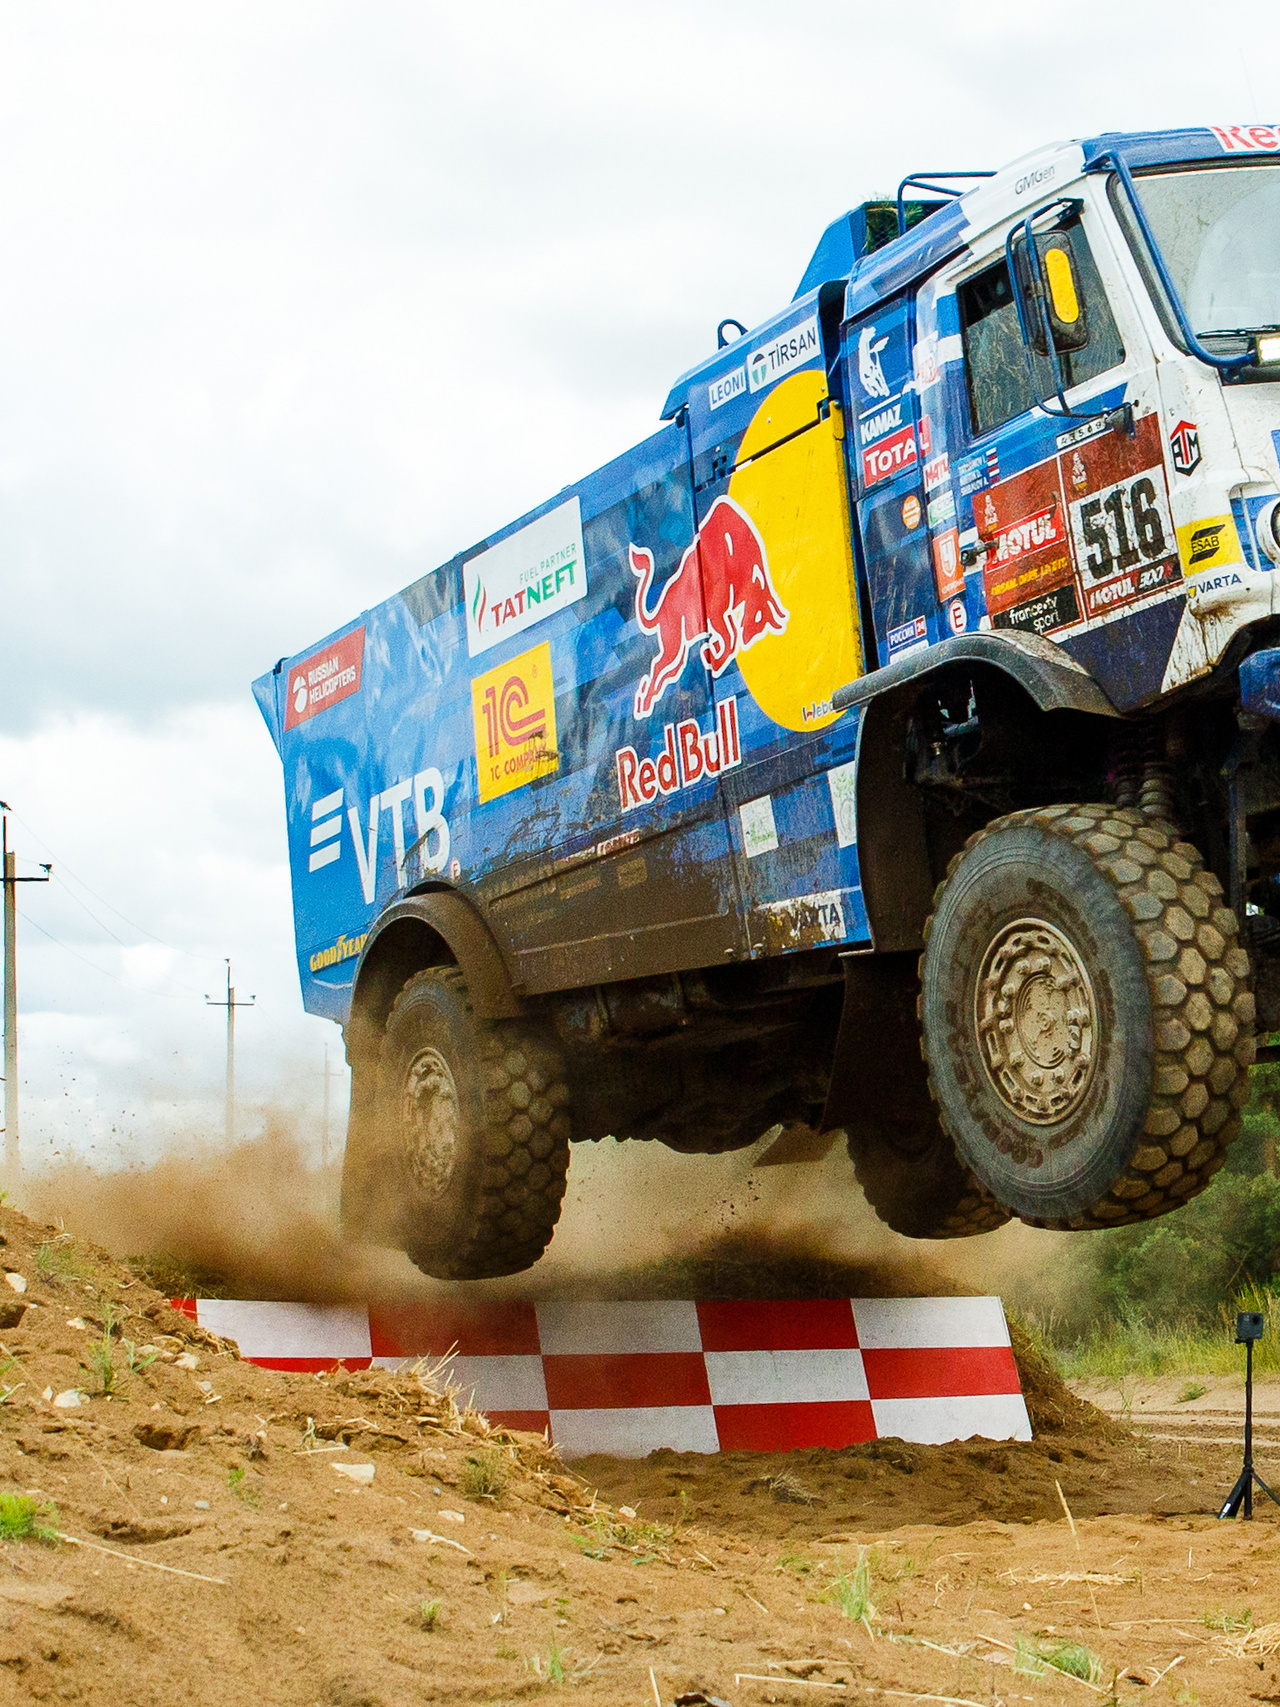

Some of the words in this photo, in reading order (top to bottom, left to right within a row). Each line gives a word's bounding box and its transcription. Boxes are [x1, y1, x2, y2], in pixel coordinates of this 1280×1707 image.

[710, 375, 745, 405] LEONI
[861, 403, 904, 445] KAMAZ
[866, 423, 930, 477] TOTAL
[992, 513, 1057, 564] MOTUL
[1080, 477, 1167, 581] 516
[1190, 535, 1220, 554] ESAB
[519, 565, 539, 585] FUEL
[540, 543, 577, 573] PARTNER
[1197, 573, 1242, 594] VARTA
[490, 560, 578, 628] TATNEFT
[1090, 577, 1135, 610] MOTUL
[1033, 609, 1061, 635] sport
[308, 656, 339, 687] RUSSIAN
[309, 664, 356, 705] HELICOPTERS
[490, 764, 501, 781] 1C
[347, 766, 451, 905] VTB
